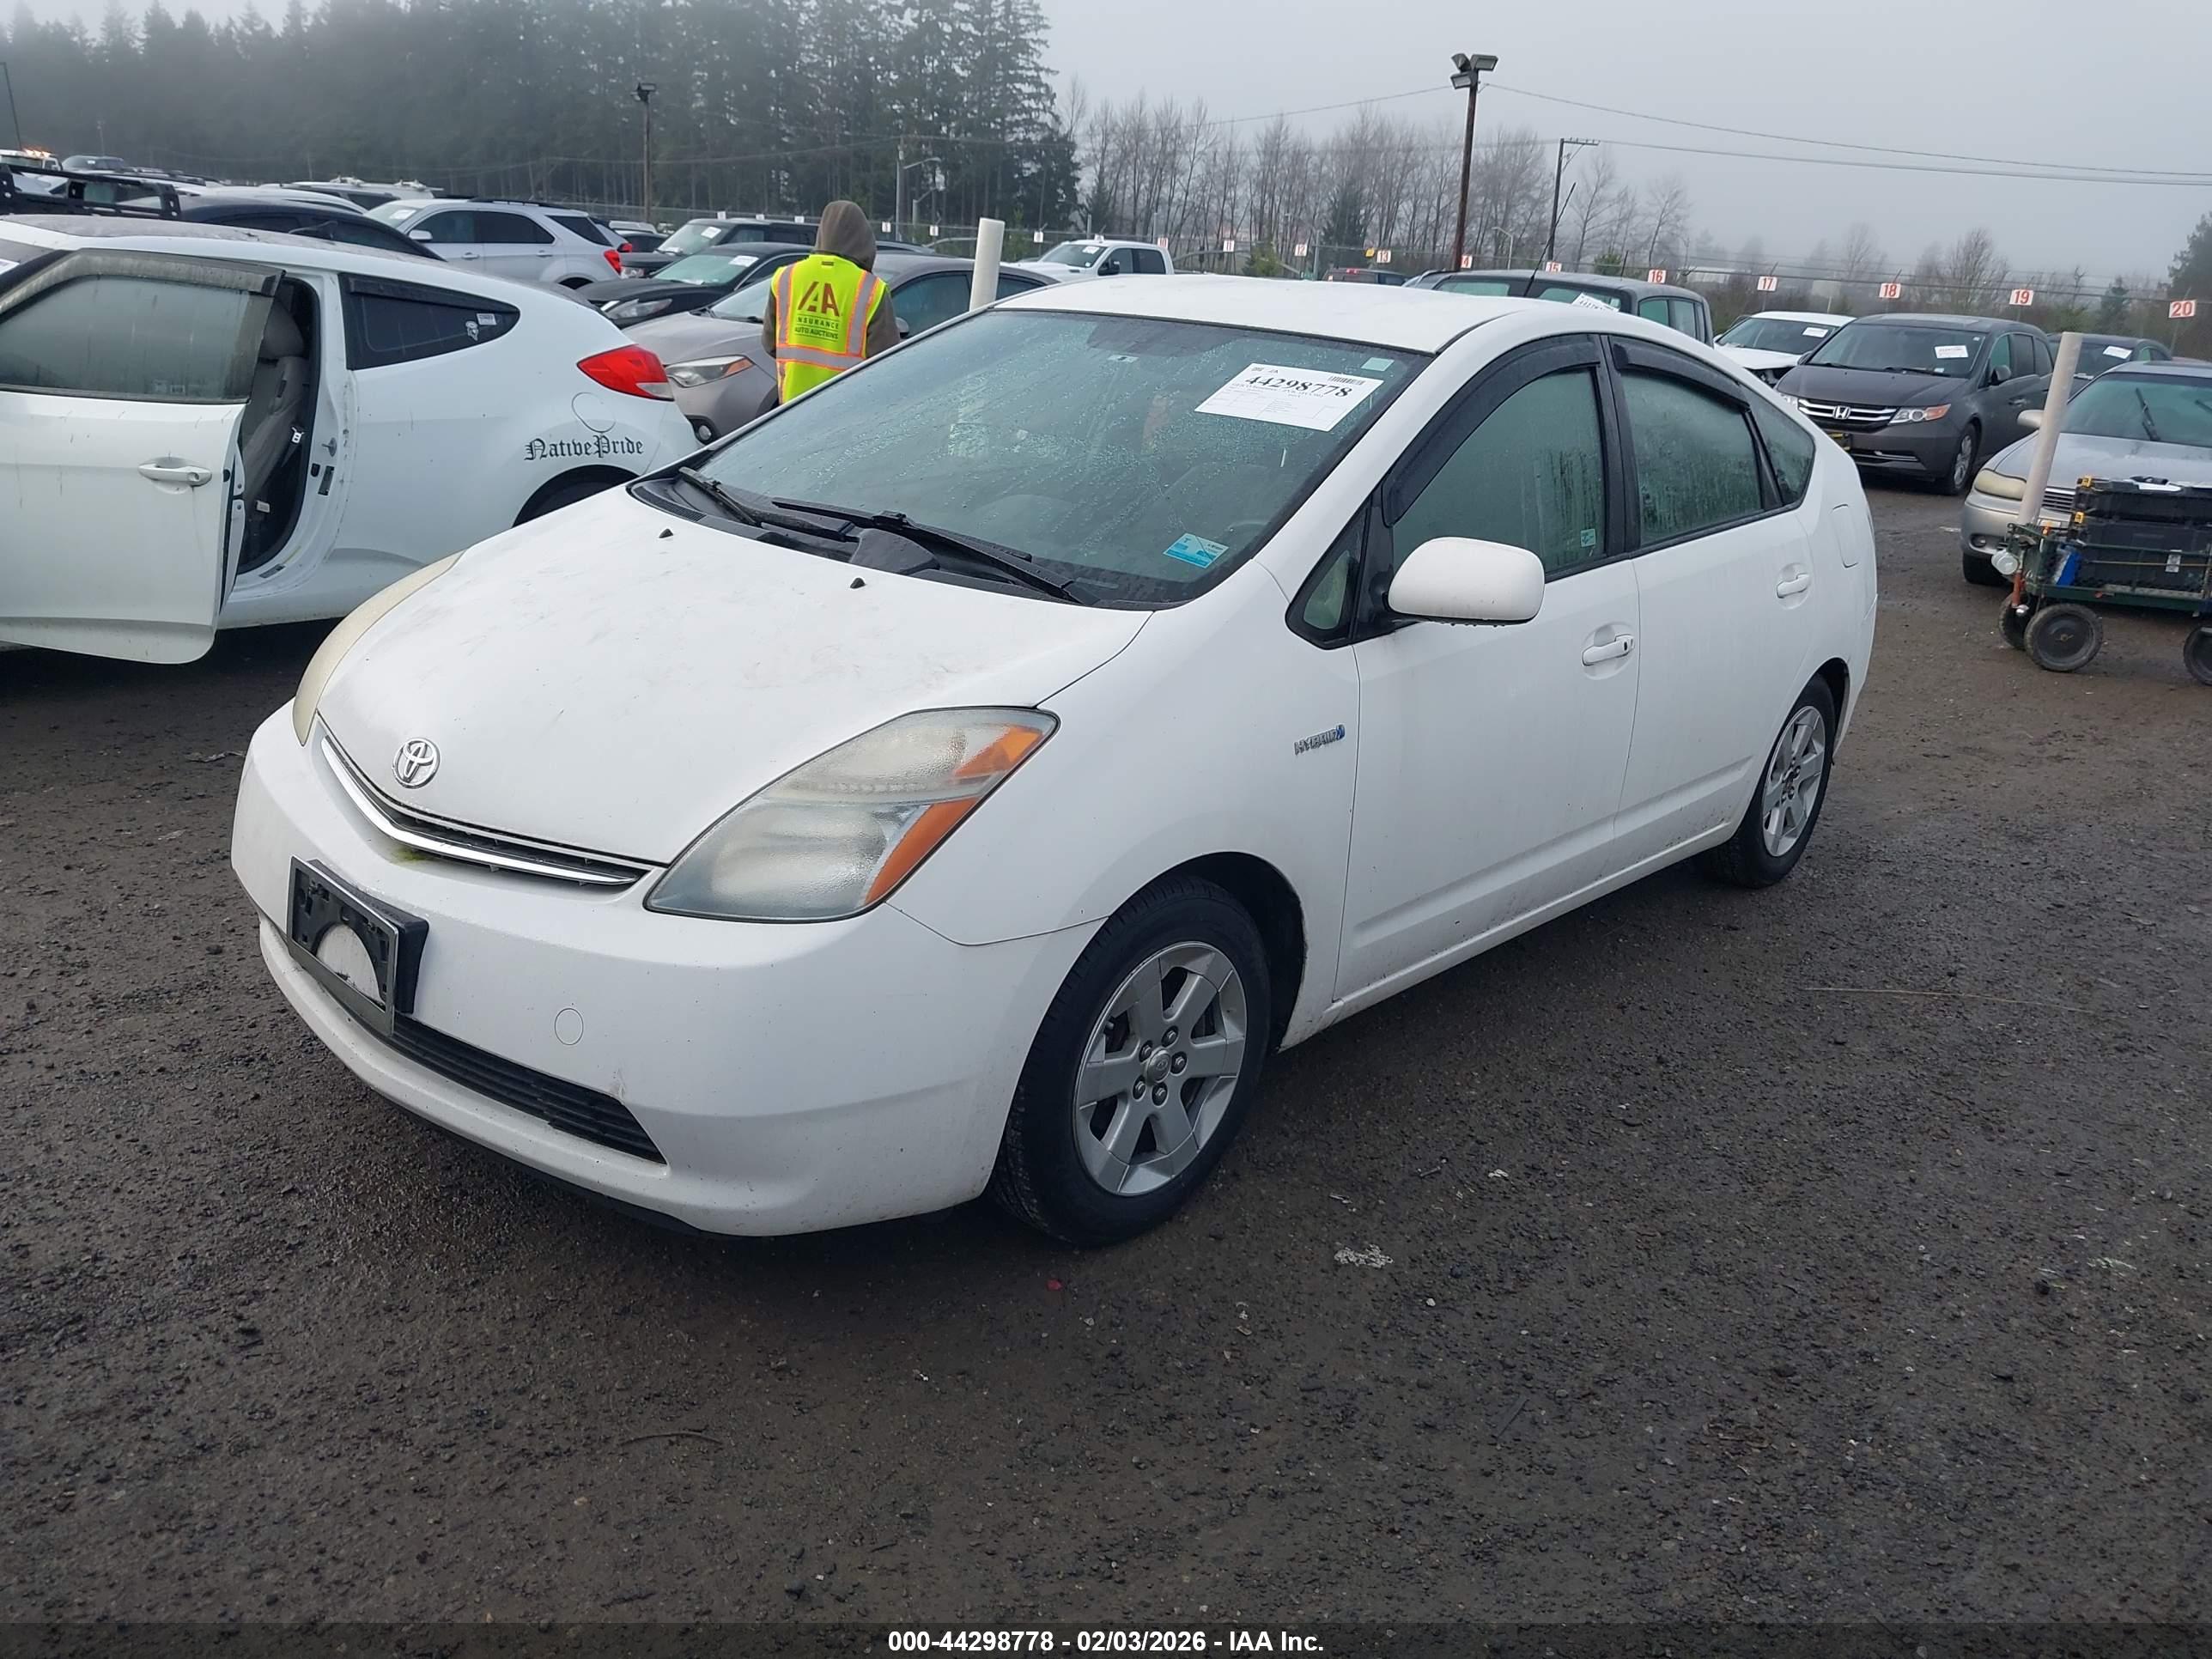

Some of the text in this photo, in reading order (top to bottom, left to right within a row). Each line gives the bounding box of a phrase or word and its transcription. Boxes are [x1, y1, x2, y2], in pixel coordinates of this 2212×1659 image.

[1548, 262, 1559, 271] 15
[1651, 270, 1663, 283] 16
[1763, 277, 1773, 289] 17
[1885, 284, 1897, 297] 18
[2014, 290, 2030, 303] 19
[2170, 301, 2191, 316] 20
[797, 317, 839, 329] NSURANCE
[1245, 376, 1352, 398] 44298778
